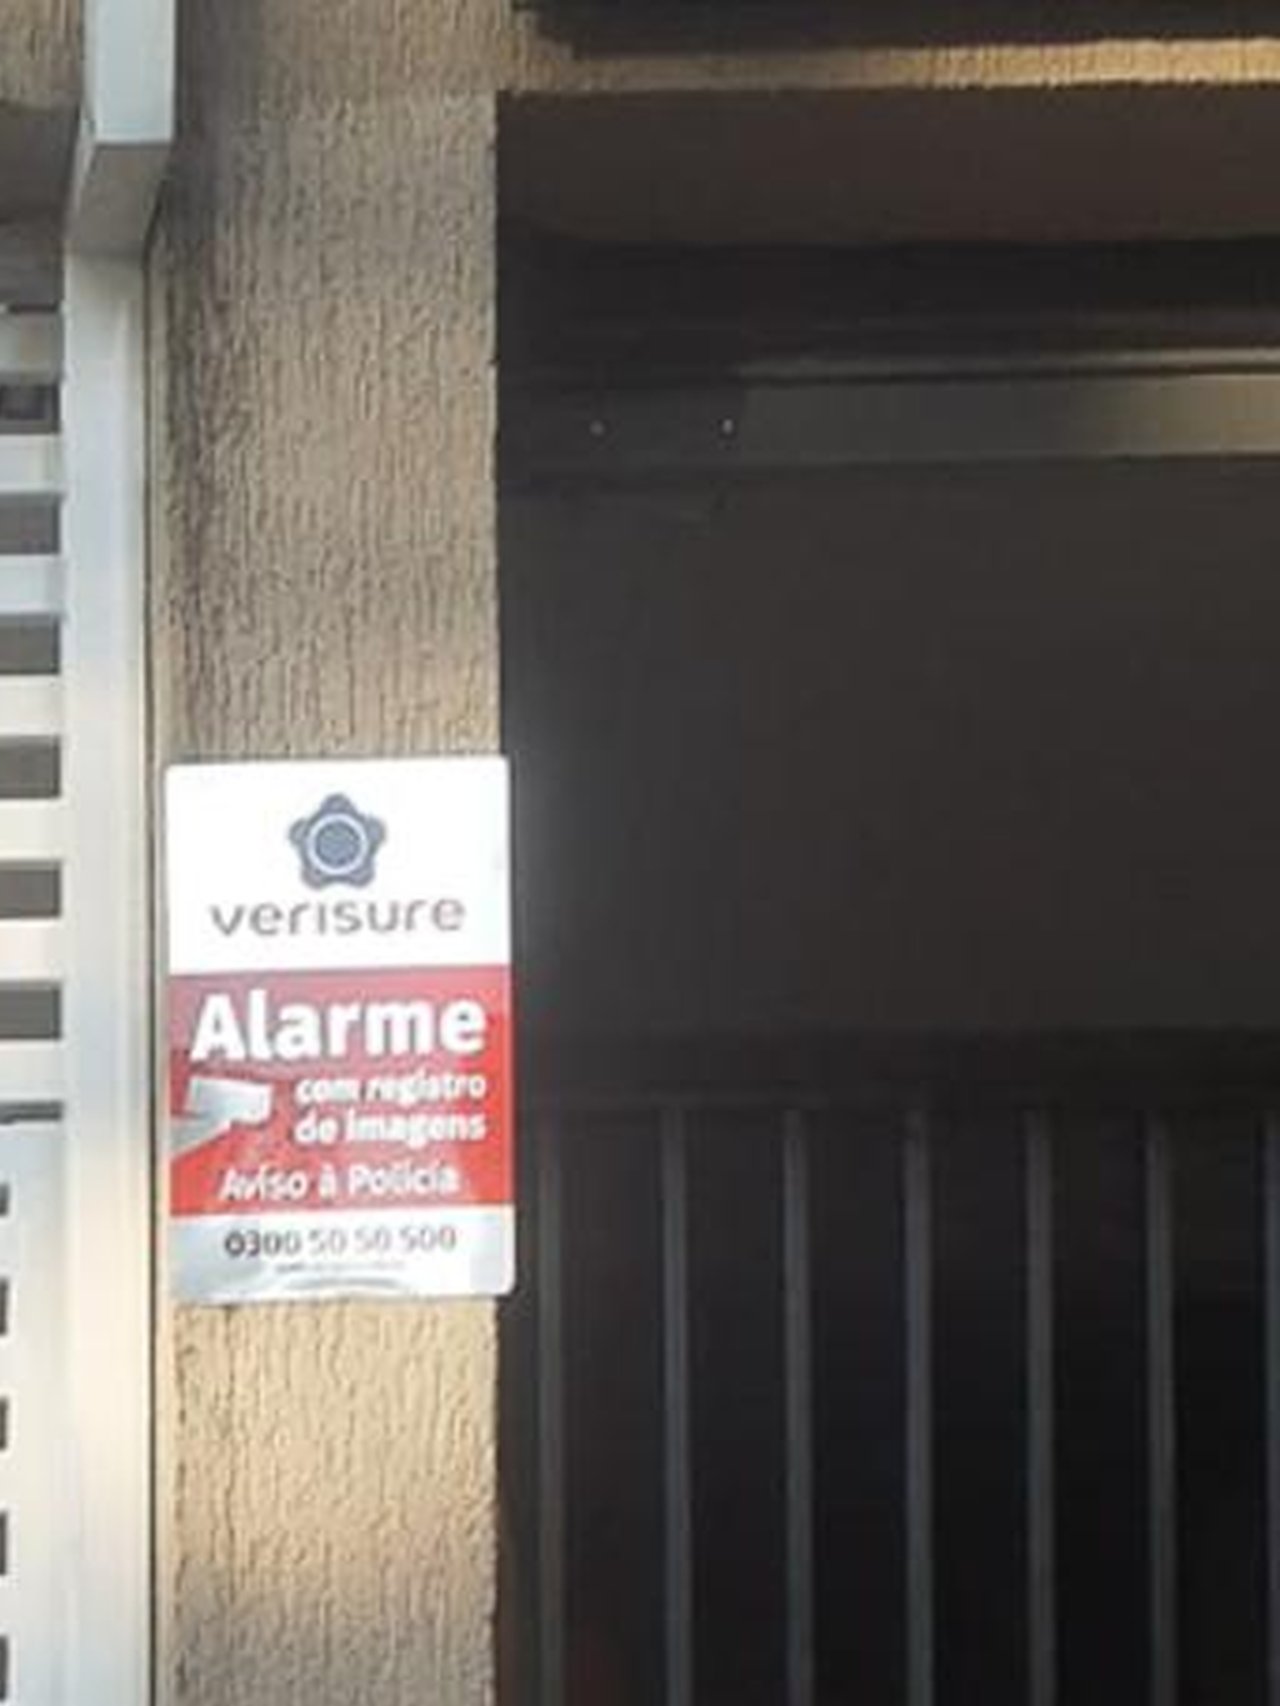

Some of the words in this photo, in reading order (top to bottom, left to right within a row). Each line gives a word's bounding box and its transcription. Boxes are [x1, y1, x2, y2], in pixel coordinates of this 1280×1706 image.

[207, 897, 466, 937] verisure
[191, 989, 488, 1061] Alarme
[296, 1078, 362, 1103] com
[367, 1069, 488, 1107] registro
[295, 1107, 338, 1144] de
[345, 1108, 488, 1149] imagens
[219, 1164, 308, 1201] Aviso
[225, 1229, 301, 1258] 0300
[309, 1227, 347, 1253] 50
[354, 1226, 390, 1252] 50
[399, 1224, 458, 1252] 500
